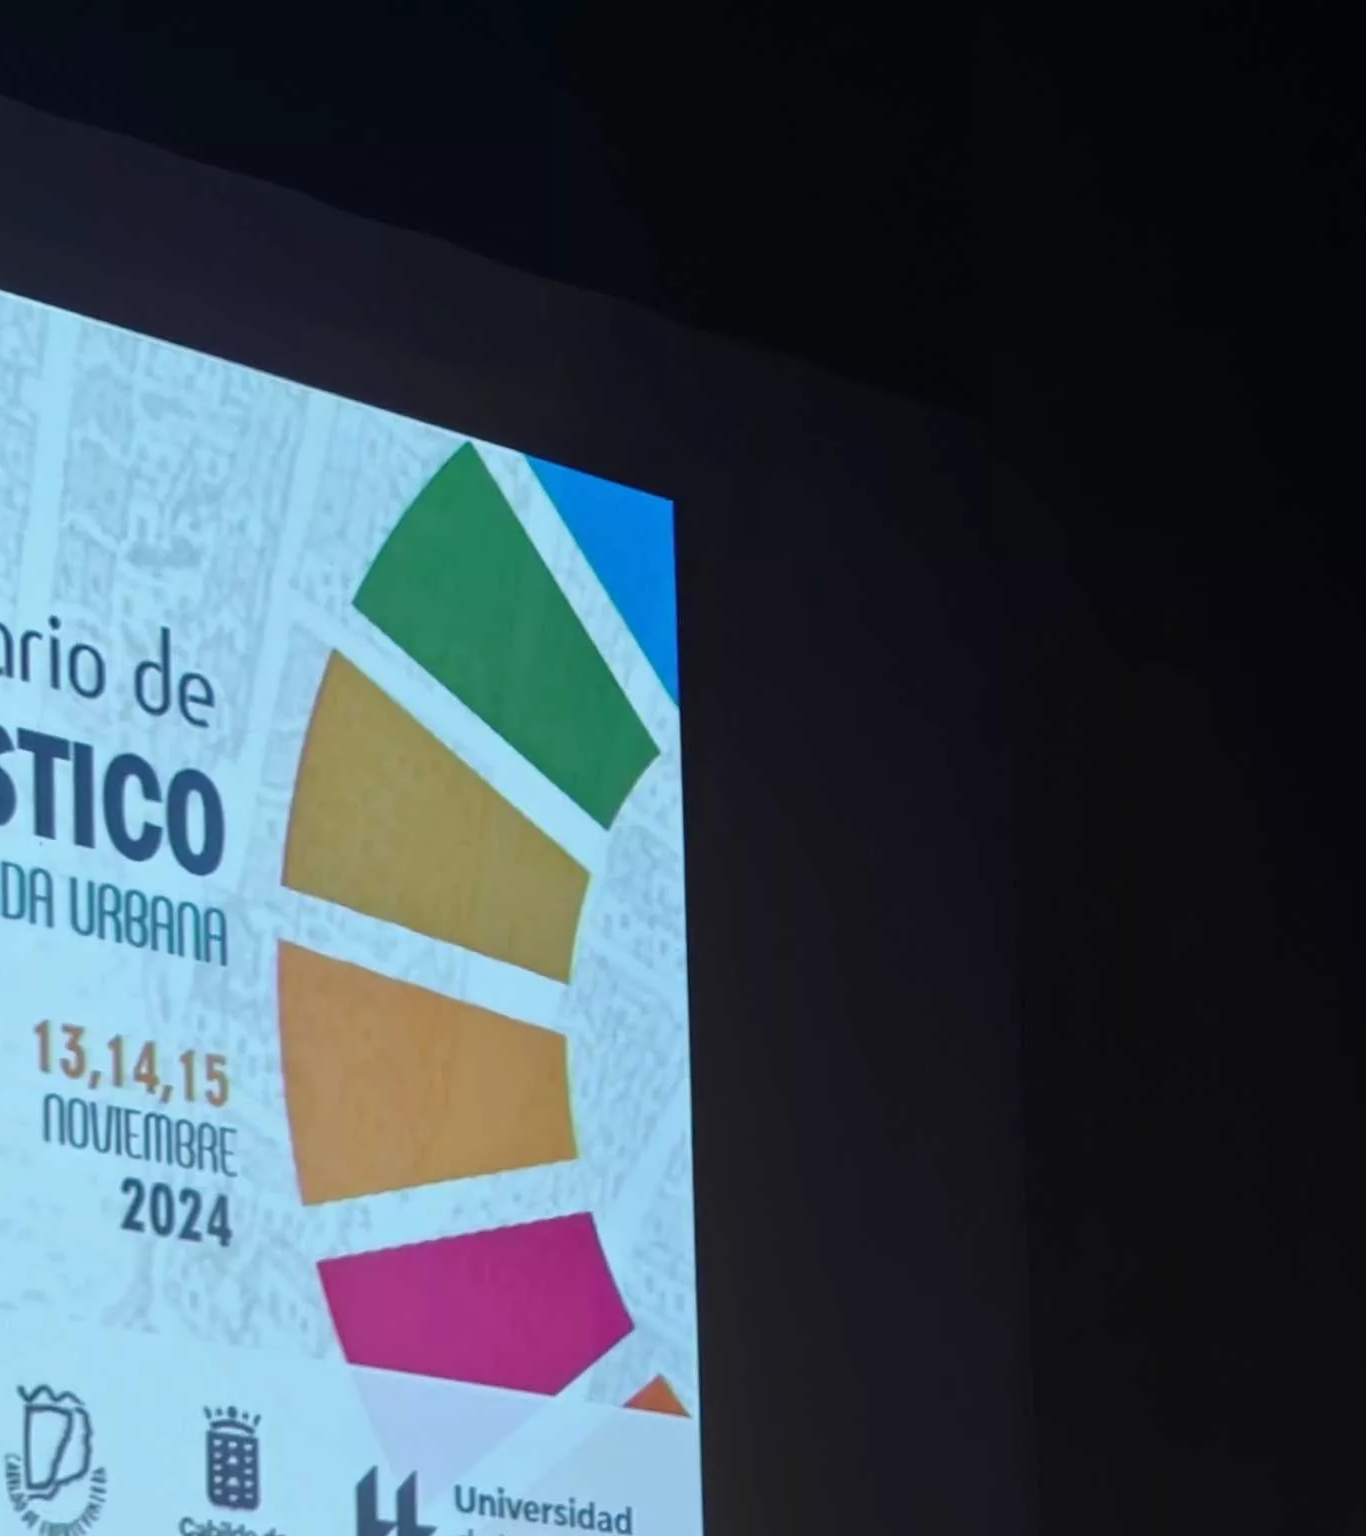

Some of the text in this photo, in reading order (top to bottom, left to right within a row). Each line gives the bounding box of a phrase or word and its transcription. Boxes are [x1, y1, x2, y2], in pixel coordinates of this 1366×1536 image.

[135, 626, 216, 729] de
[69, 875, 229, 967] URBANA
[33, 1019, 230, 1109] 13,14,15
[42, 1093, 239, 1178] NOVIEMBRE
[120, 1177, 233, 1247] 2024
[454, 1483, 634, 1536] Universidad
